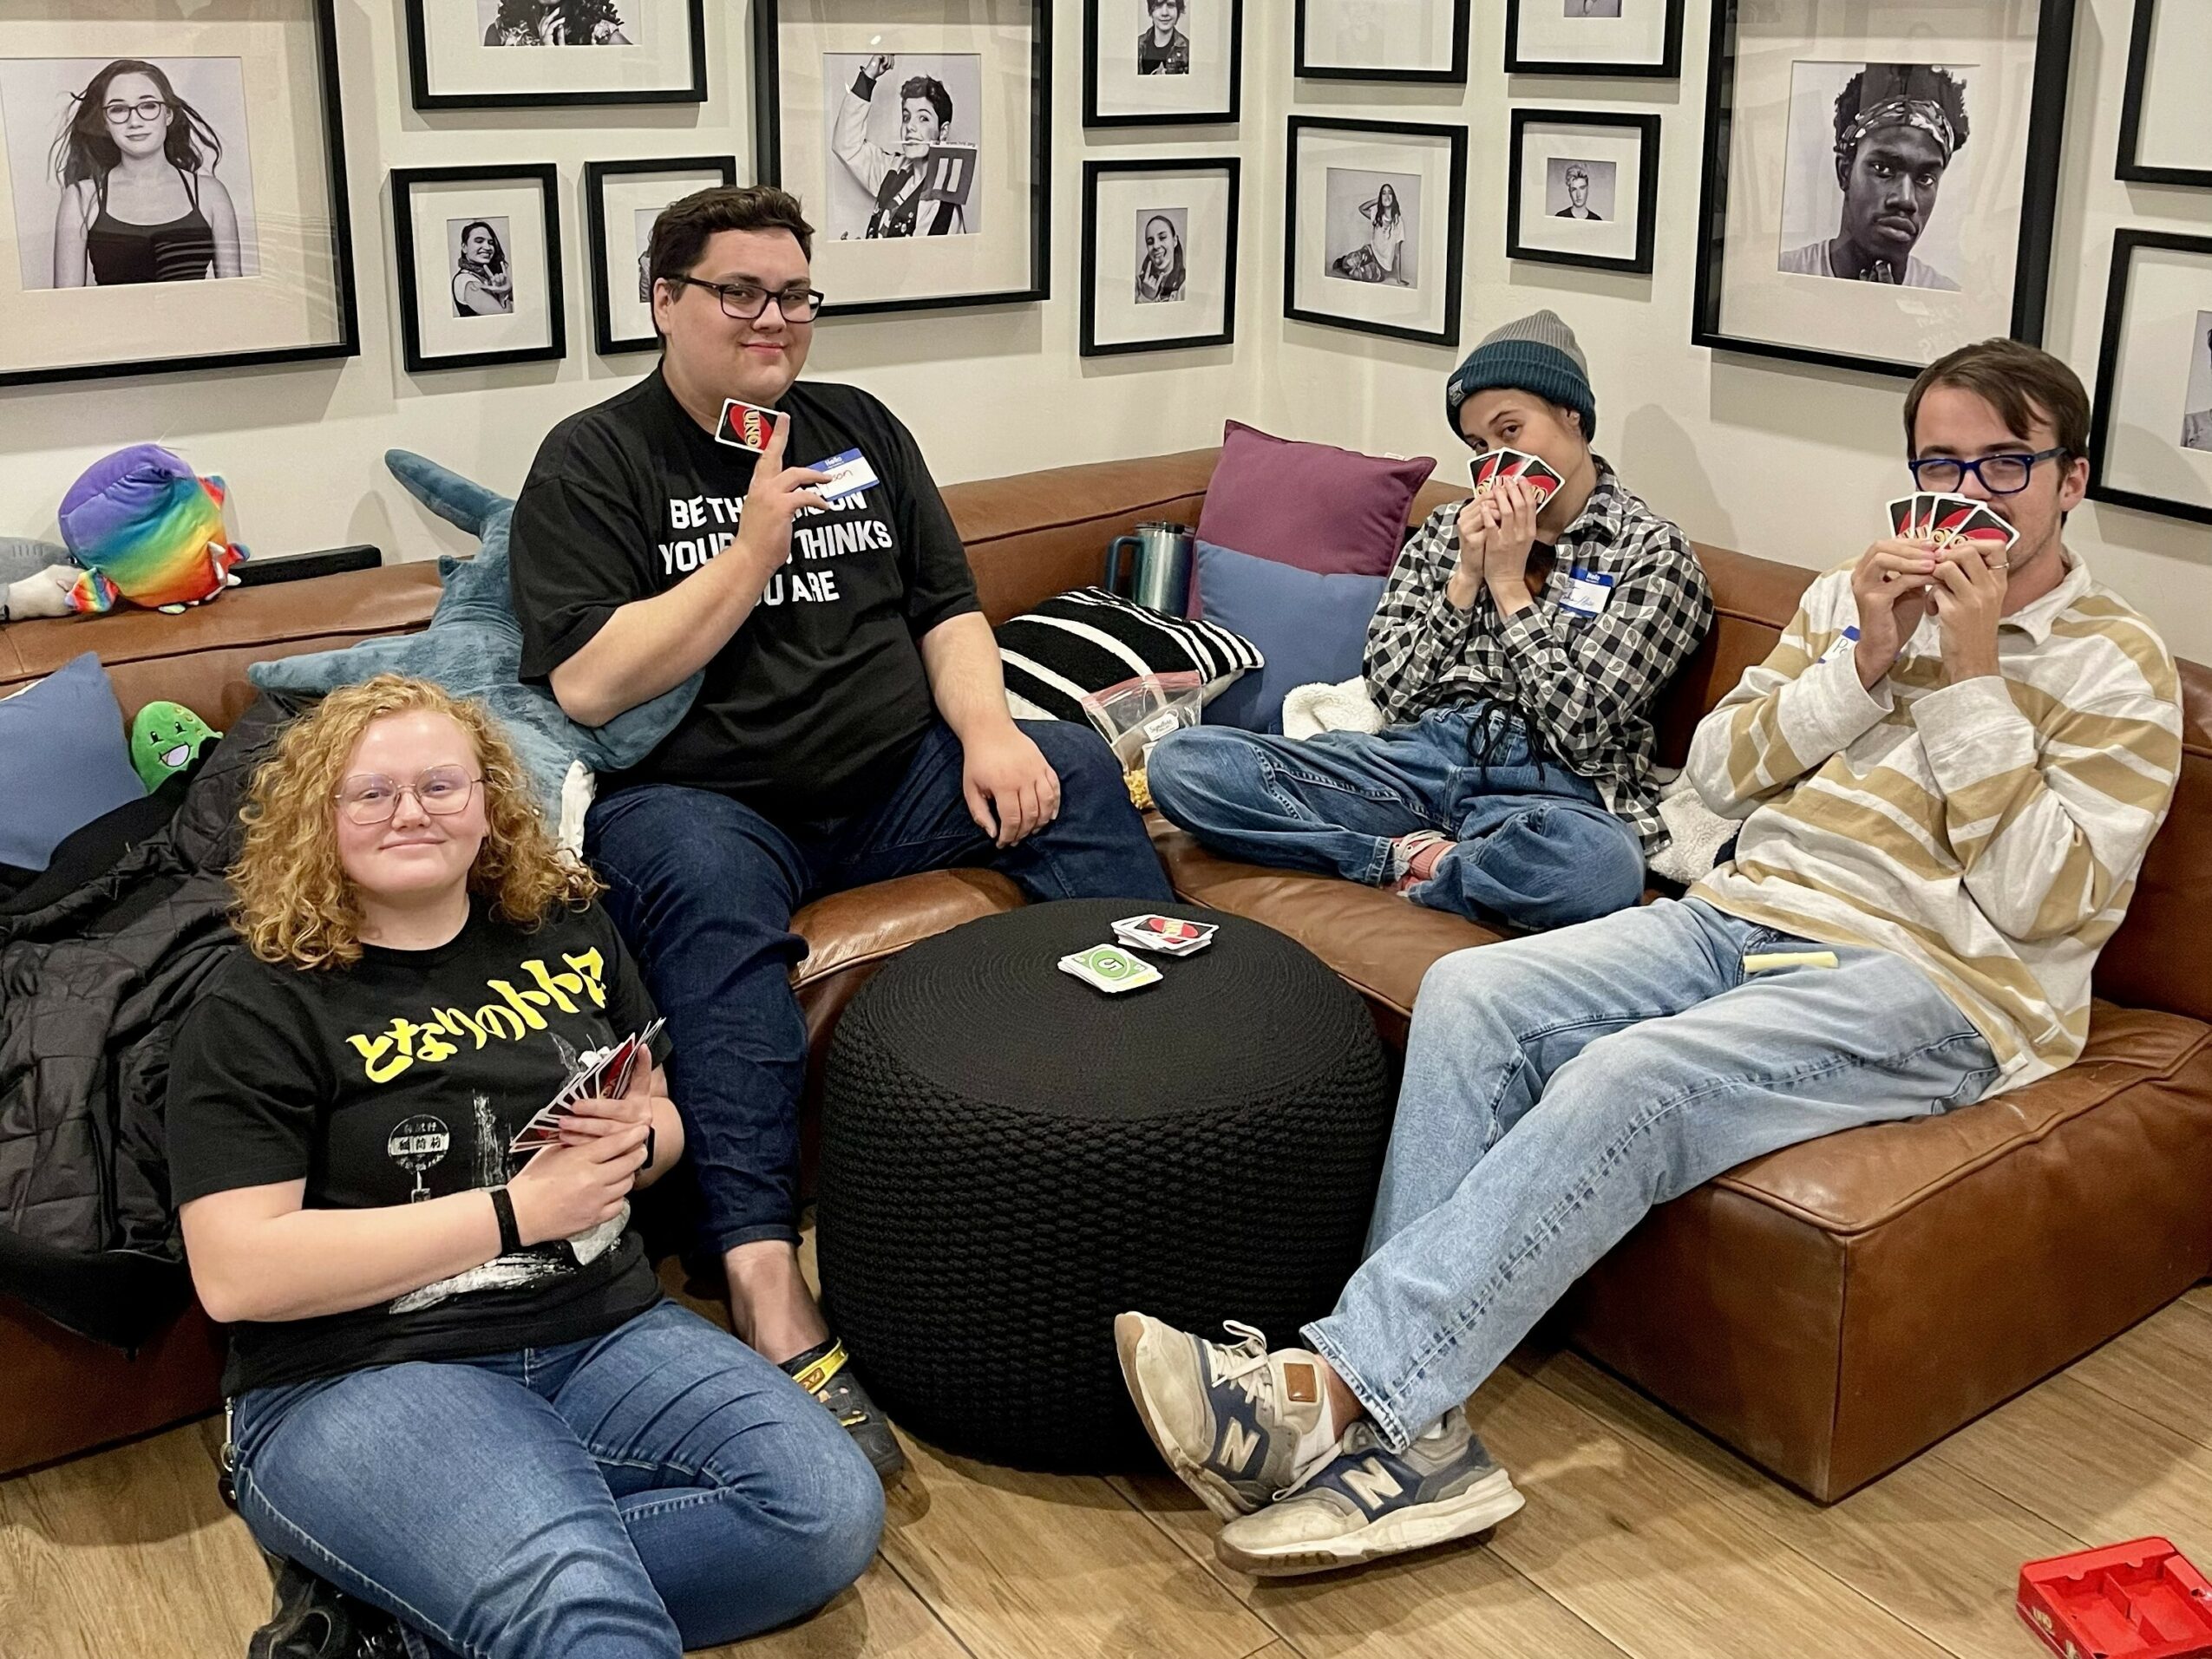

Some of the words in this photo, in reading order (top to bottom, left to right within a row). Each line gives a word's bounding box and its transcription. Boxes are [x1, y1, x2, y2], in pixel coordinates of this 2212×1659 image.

[743, 409, 762, 448] UNO
[825, 456, 843, 467] Hello
[670, 494, 708, 529] BE
[705, 494, 748, 524] TH
[794, 520, 893, 560] THINKS
[791, 570, 841, 603] ARE
[1096, 957, 1125, 972] 5
[1216, 1416, 1261, 1473] N
[1339, 1456, 1404, 1511] N
